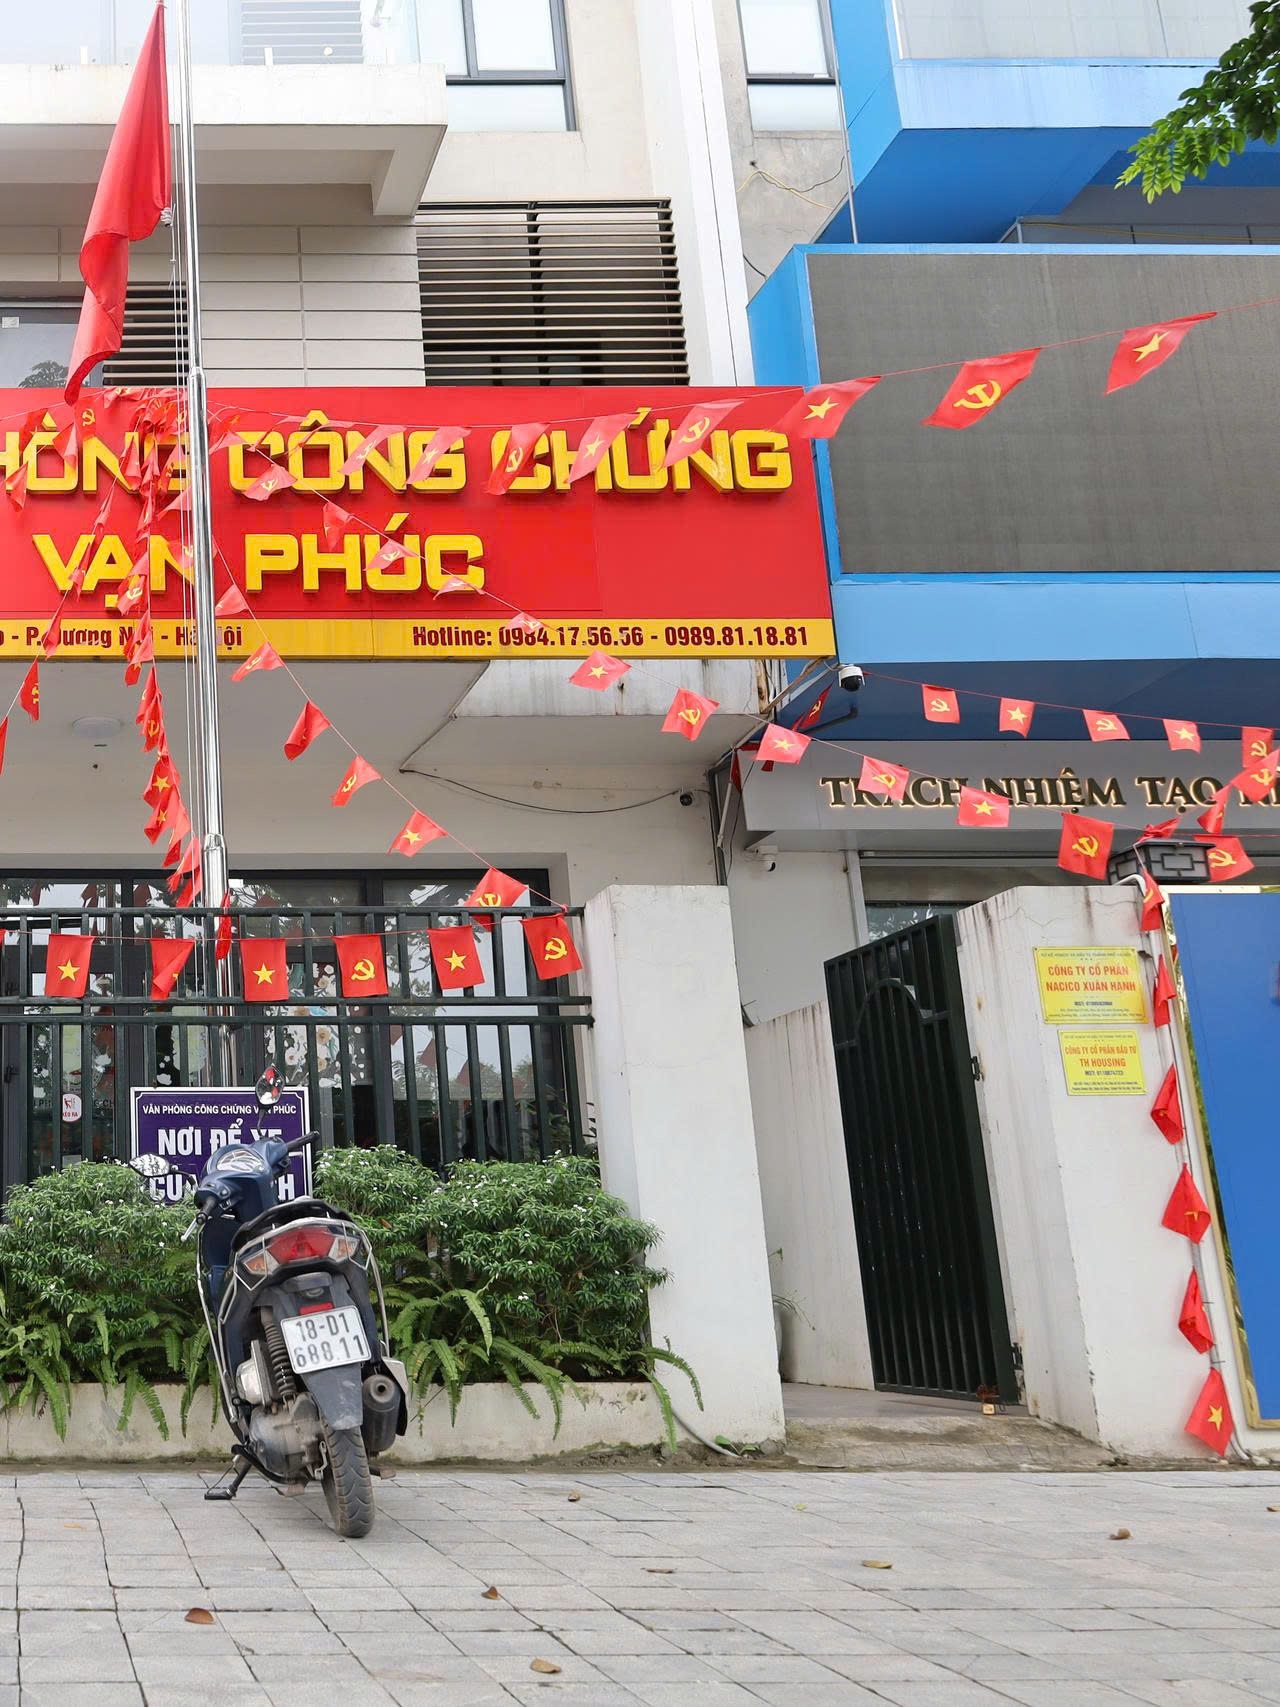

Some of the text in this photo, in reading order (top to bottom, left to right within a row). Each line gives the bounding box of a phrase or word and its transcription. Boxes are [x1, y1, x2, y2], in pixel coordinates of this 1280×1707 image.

[229, 409, 467, 495] CÔNG
[245, 512, 485, 594] PHÚC
[47, 626, 111, 648] ương
[413, 626, 493, 646] Hotline:
[498, 626, 644, 647] 0984.17.56.56
[665, 627, 808, 646] 0989.81.18.81
[1136, 776, 1225, 814] TẠO
[1091, 1058, 1126, 1067] HOUSING
[143, 1104, 160, 1114] VĂN
[162, 1103, 192, 1114] PHÒNG
[194, 1103, 219, 1114] CÔNG
[221, 1103, 252, 1114] CHỨNG
[273, 1103, 296, 1114] PHÚC
[158, 1126, 202, 1156] NƠI
[296, 1312, 350, 1342] 18-D1
